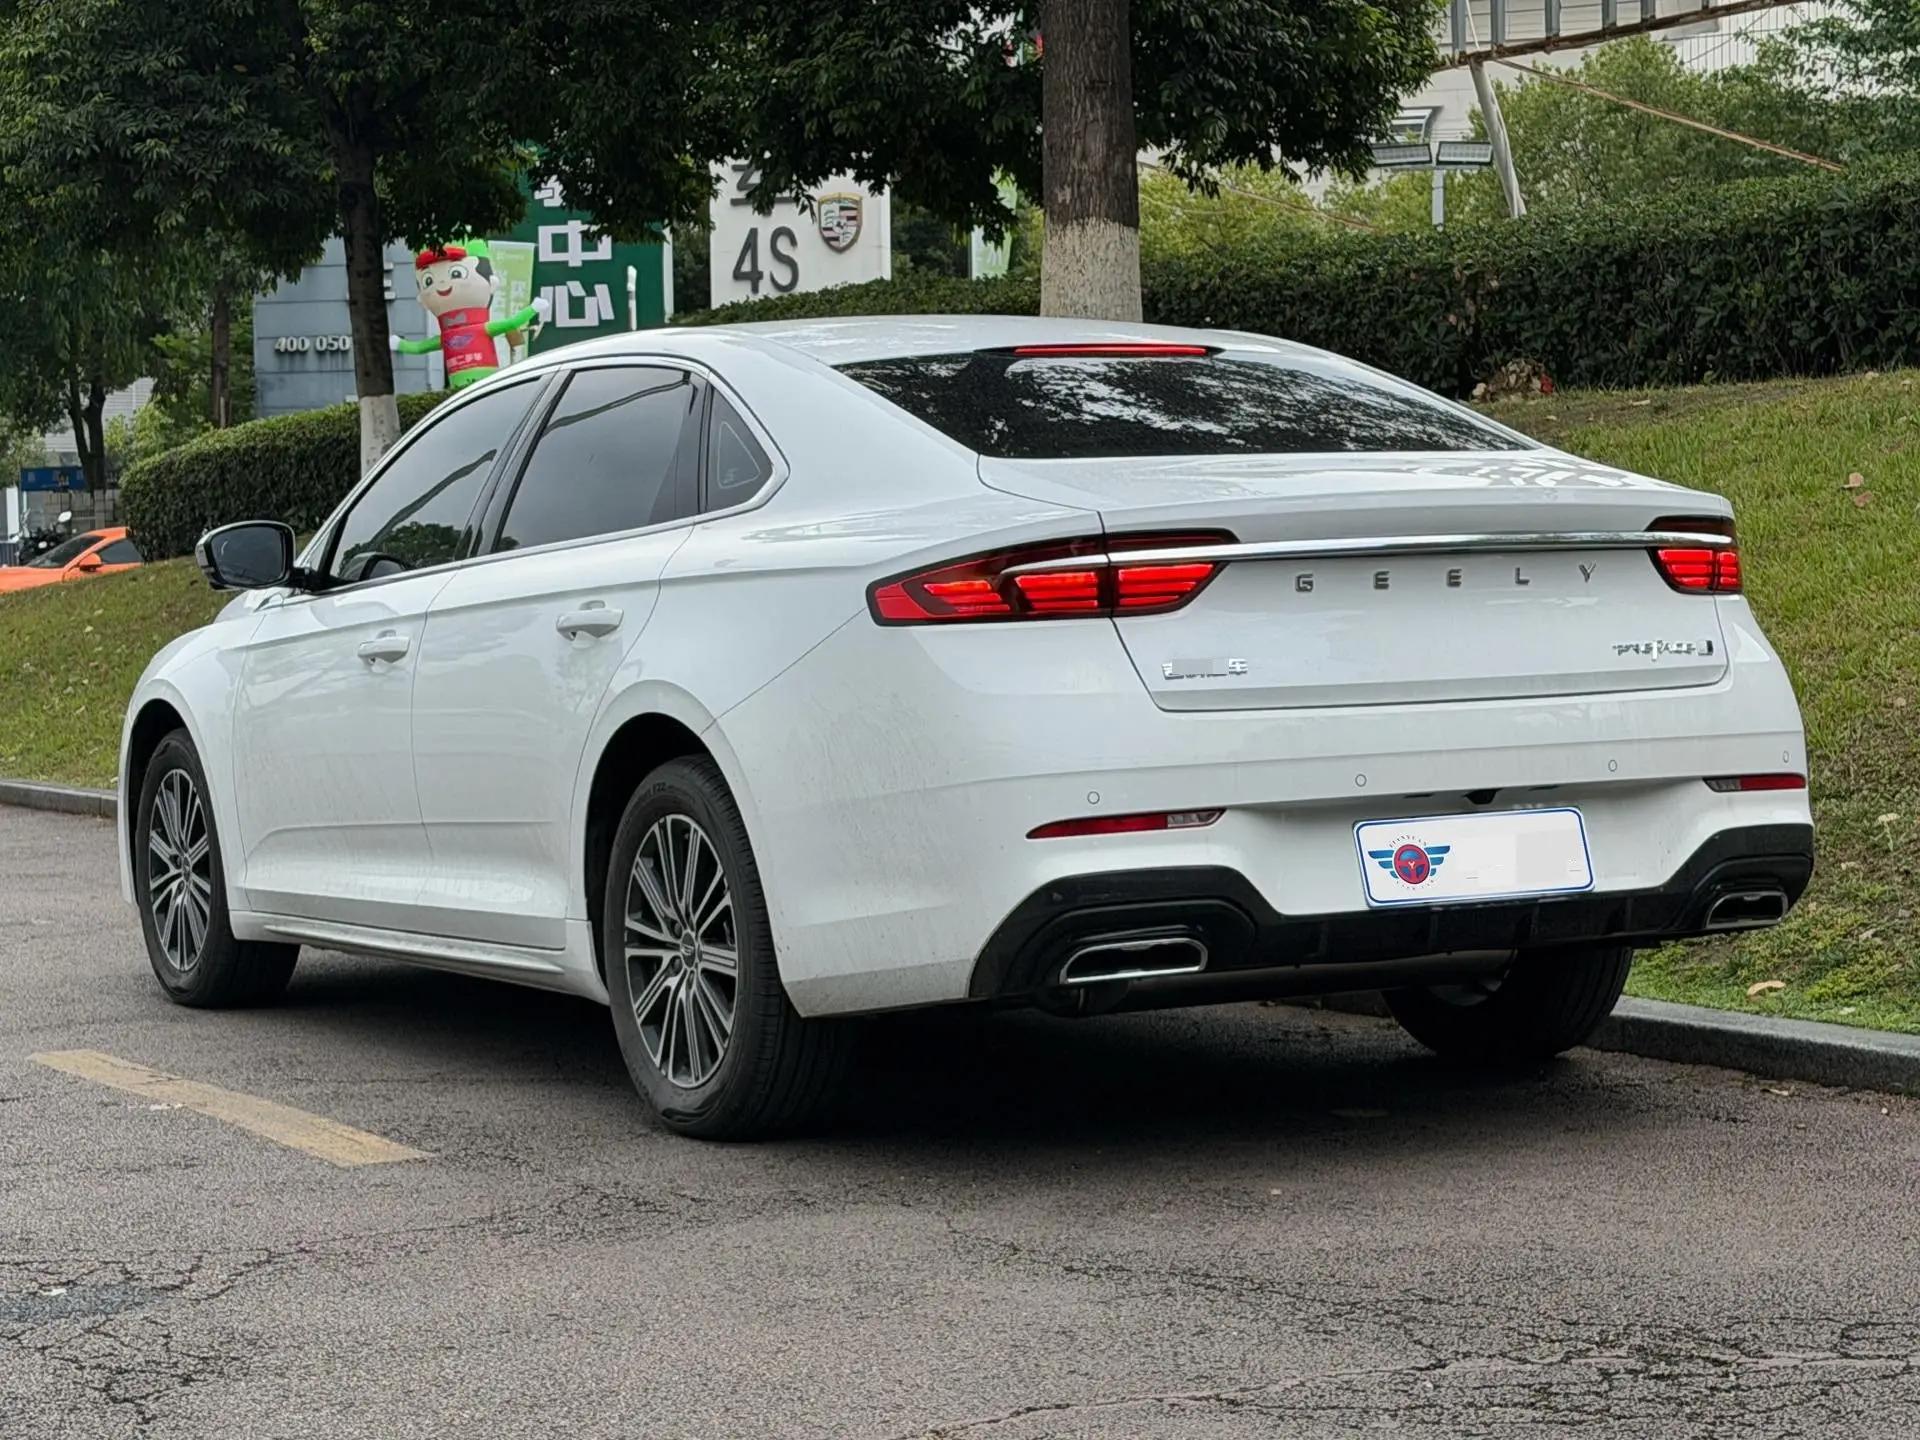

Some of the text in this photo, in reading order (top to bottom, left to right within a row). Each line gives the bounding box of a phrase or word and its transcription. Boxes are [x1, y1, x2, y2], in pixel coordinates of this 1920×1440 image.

[534, 176, 615, 327] 中心
[732, 226, 799, 294] 4S
[275, 335, 350, 352] 400 050
[1295, 560, 1597, 593] GEELY
